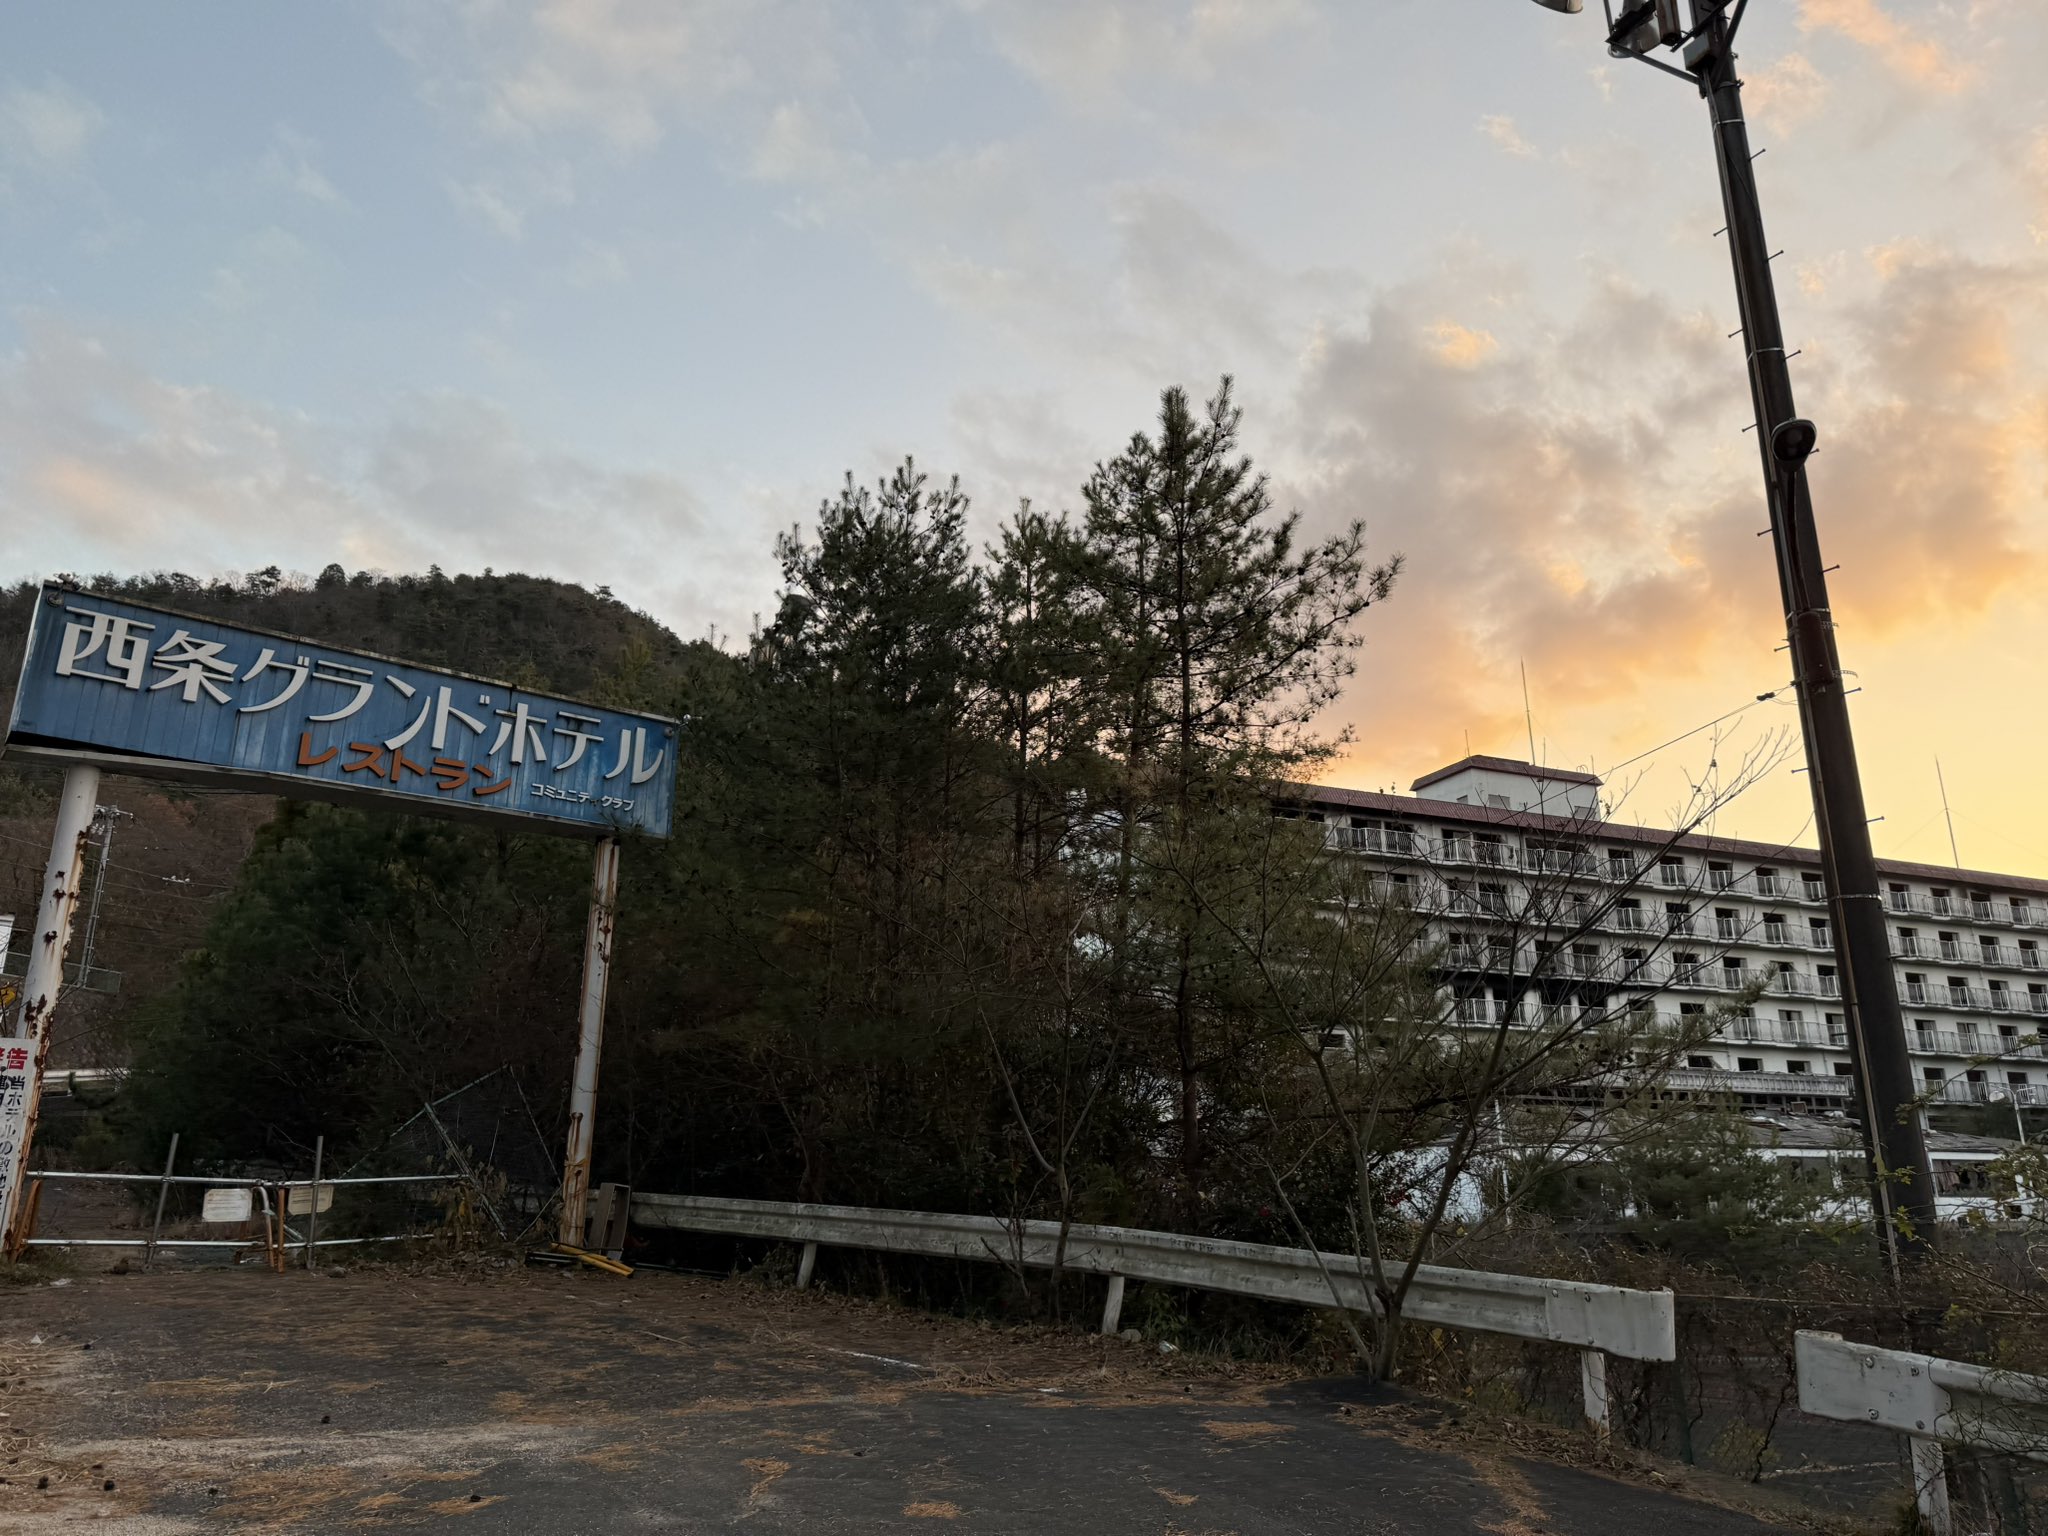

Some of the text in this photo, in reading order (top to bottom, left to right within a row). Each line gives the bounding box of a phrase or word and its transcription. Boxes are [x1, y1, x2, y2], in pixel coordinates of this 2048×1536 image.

[56, 605, 664, 784] 西条グランドホテル
[297, 732, 512, 795] レストラン
[0, 1047, 28, 1070] 告
